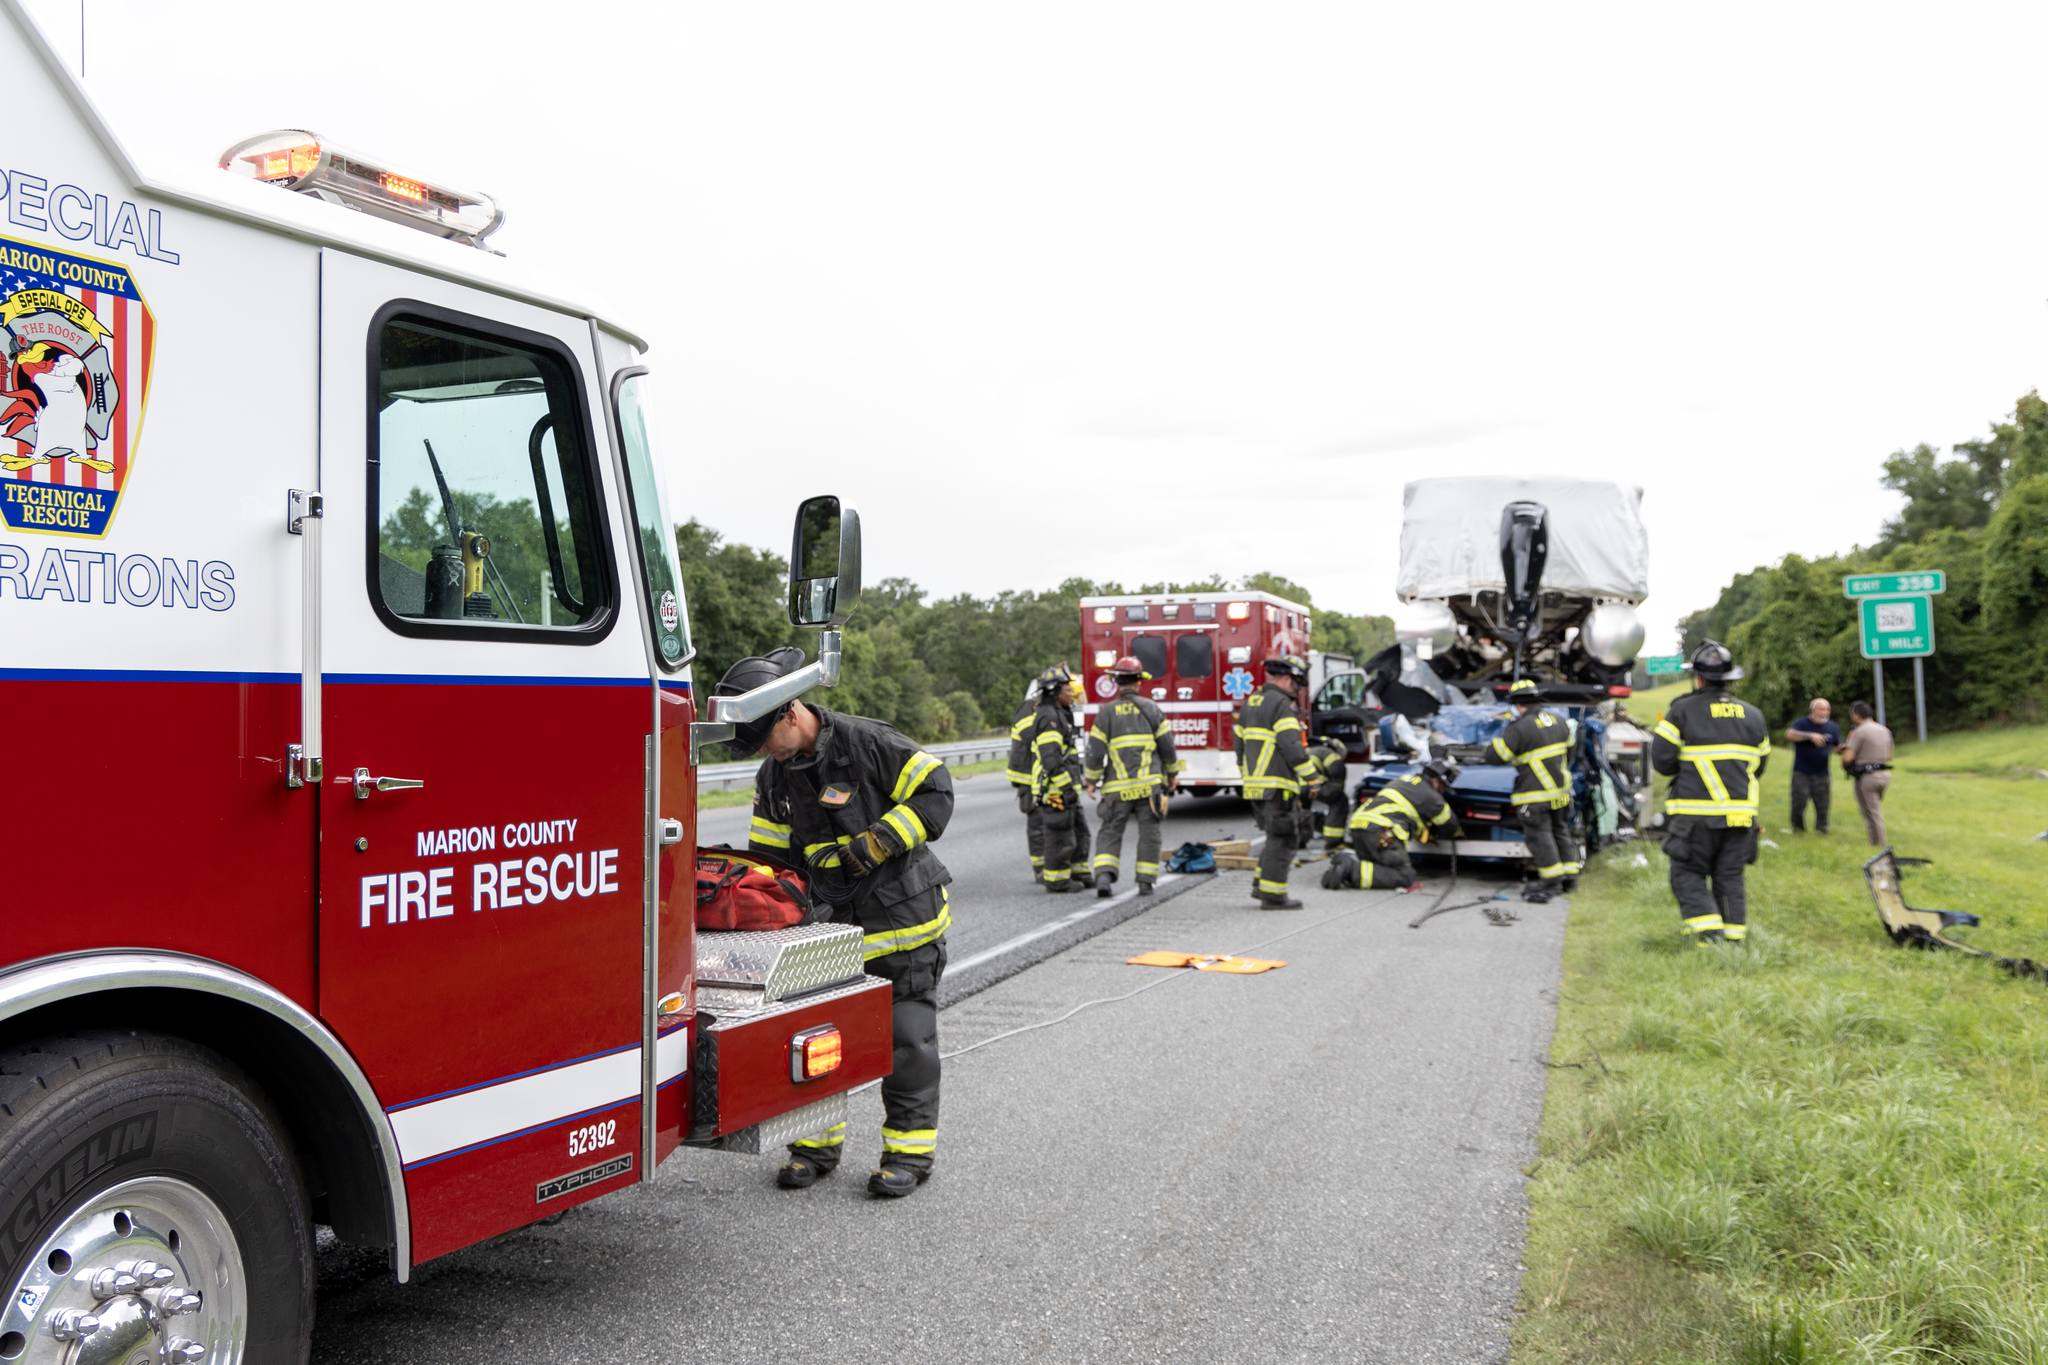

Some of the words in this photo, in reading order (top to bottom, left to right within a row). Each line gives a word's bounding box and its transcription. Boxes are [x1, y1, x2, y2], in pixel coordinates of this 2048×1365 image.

[0, 168, 179, 266] ECIAL
[58, 261, 127, 292] COUNTY
[18, 291, 61, 309] SPECIAL
[65, 300, 87, 320] OPS
[22, 322, 45, 336] THE
[48, 324, 83, 345] ROOST
[4, 483, 105, 512] TECHNICAL
[22, 504, 90, 528] RESCUE
[417, 826, 496, 857] MARION
[502, 818, 578, 849] COUNTY
[360, 866, 454, 929] FIRE
[473, 848, 619, 912] RESCUE
[568, 1119, 616, 1157] 52392
[540, 1157, 630, 1196] TYPHOON
